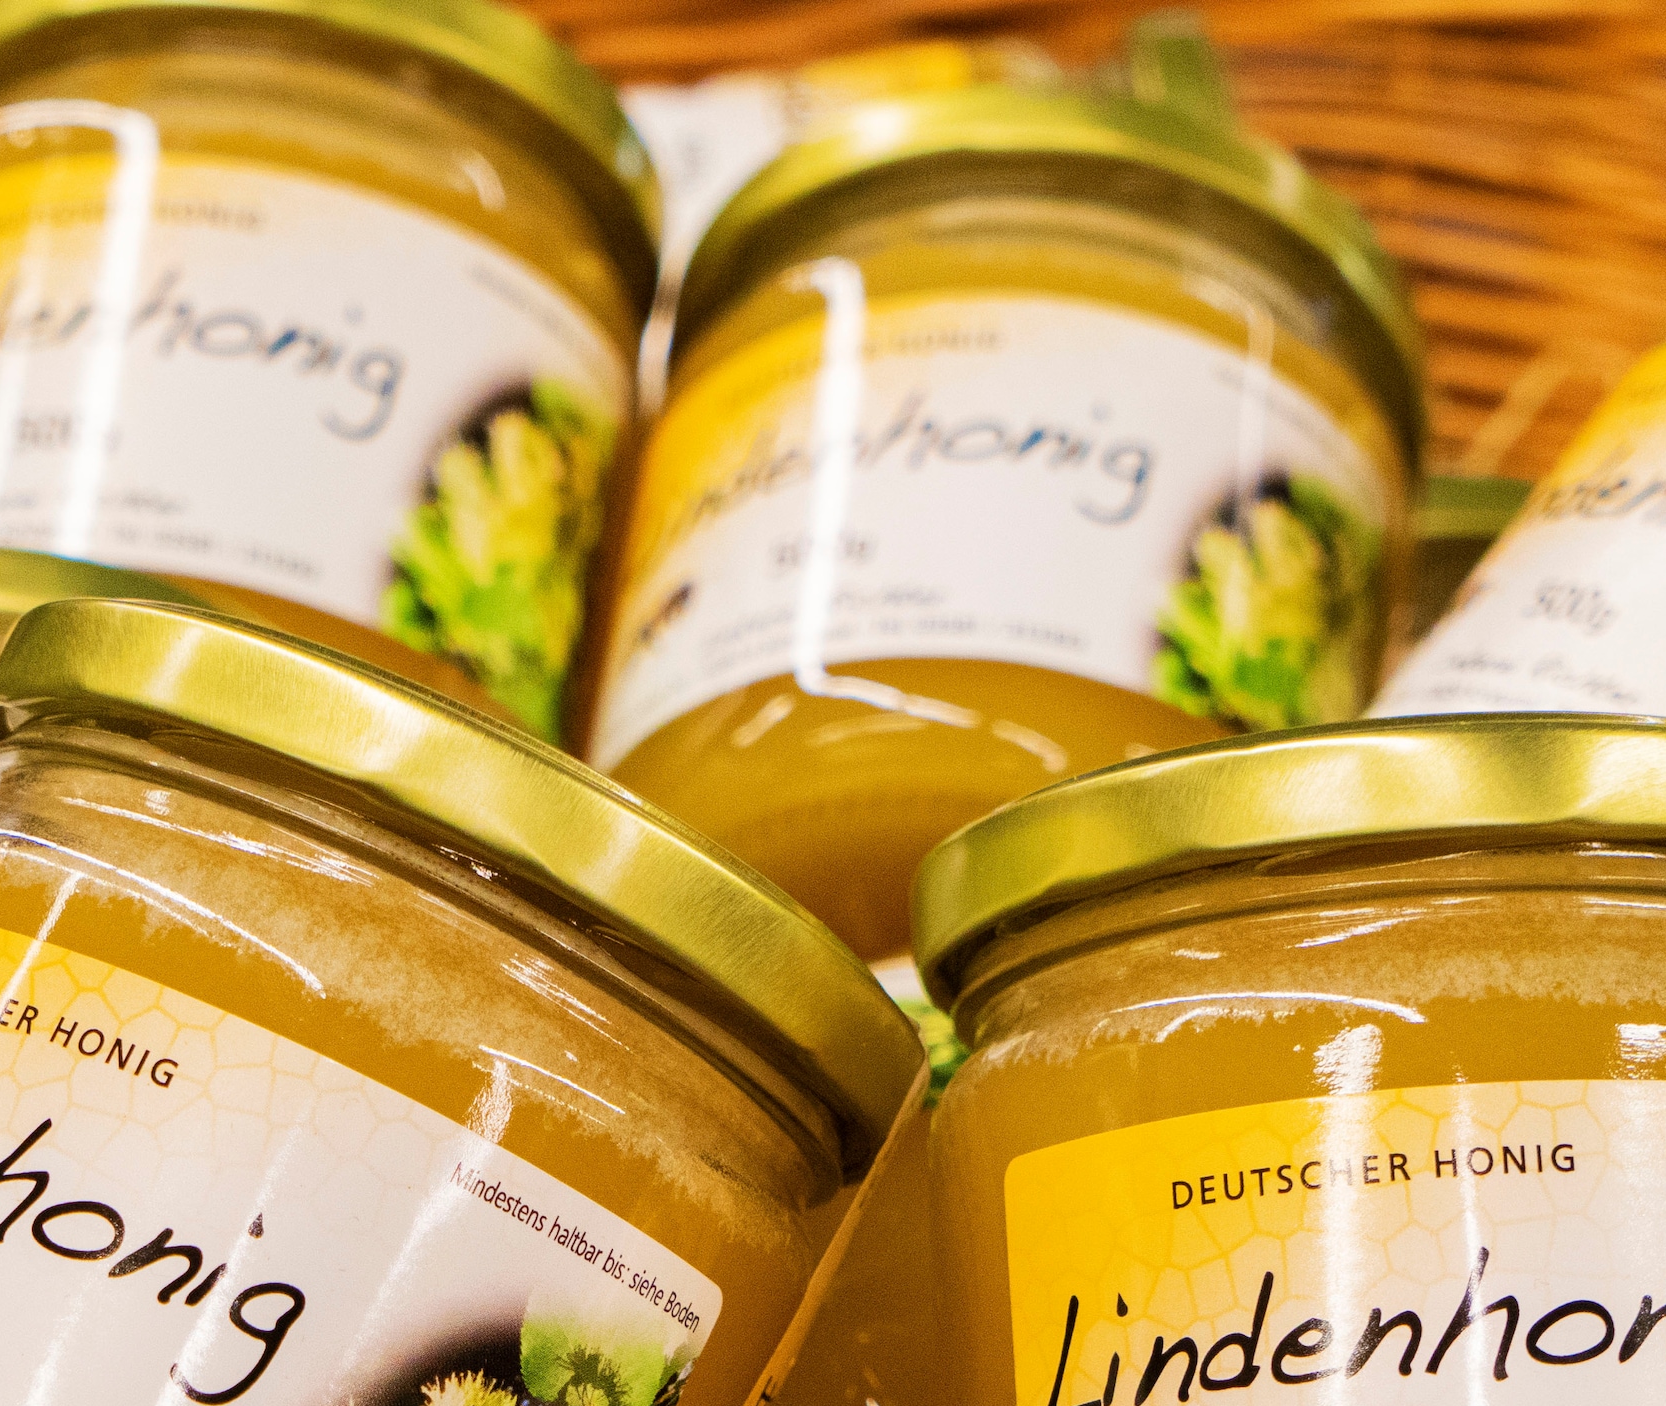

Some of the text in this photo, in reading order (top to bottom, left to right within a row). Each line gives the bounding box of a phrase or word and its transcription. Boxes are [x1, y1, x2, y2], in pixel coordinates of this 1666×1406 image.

[50, 1017, 179, 1088] HONIG
[1172, 1144, 1578, 1210] DEUTSCHER HONIG
[449, 1161, 701, 1333] Mindestens haltbar bis: siehe Boden
